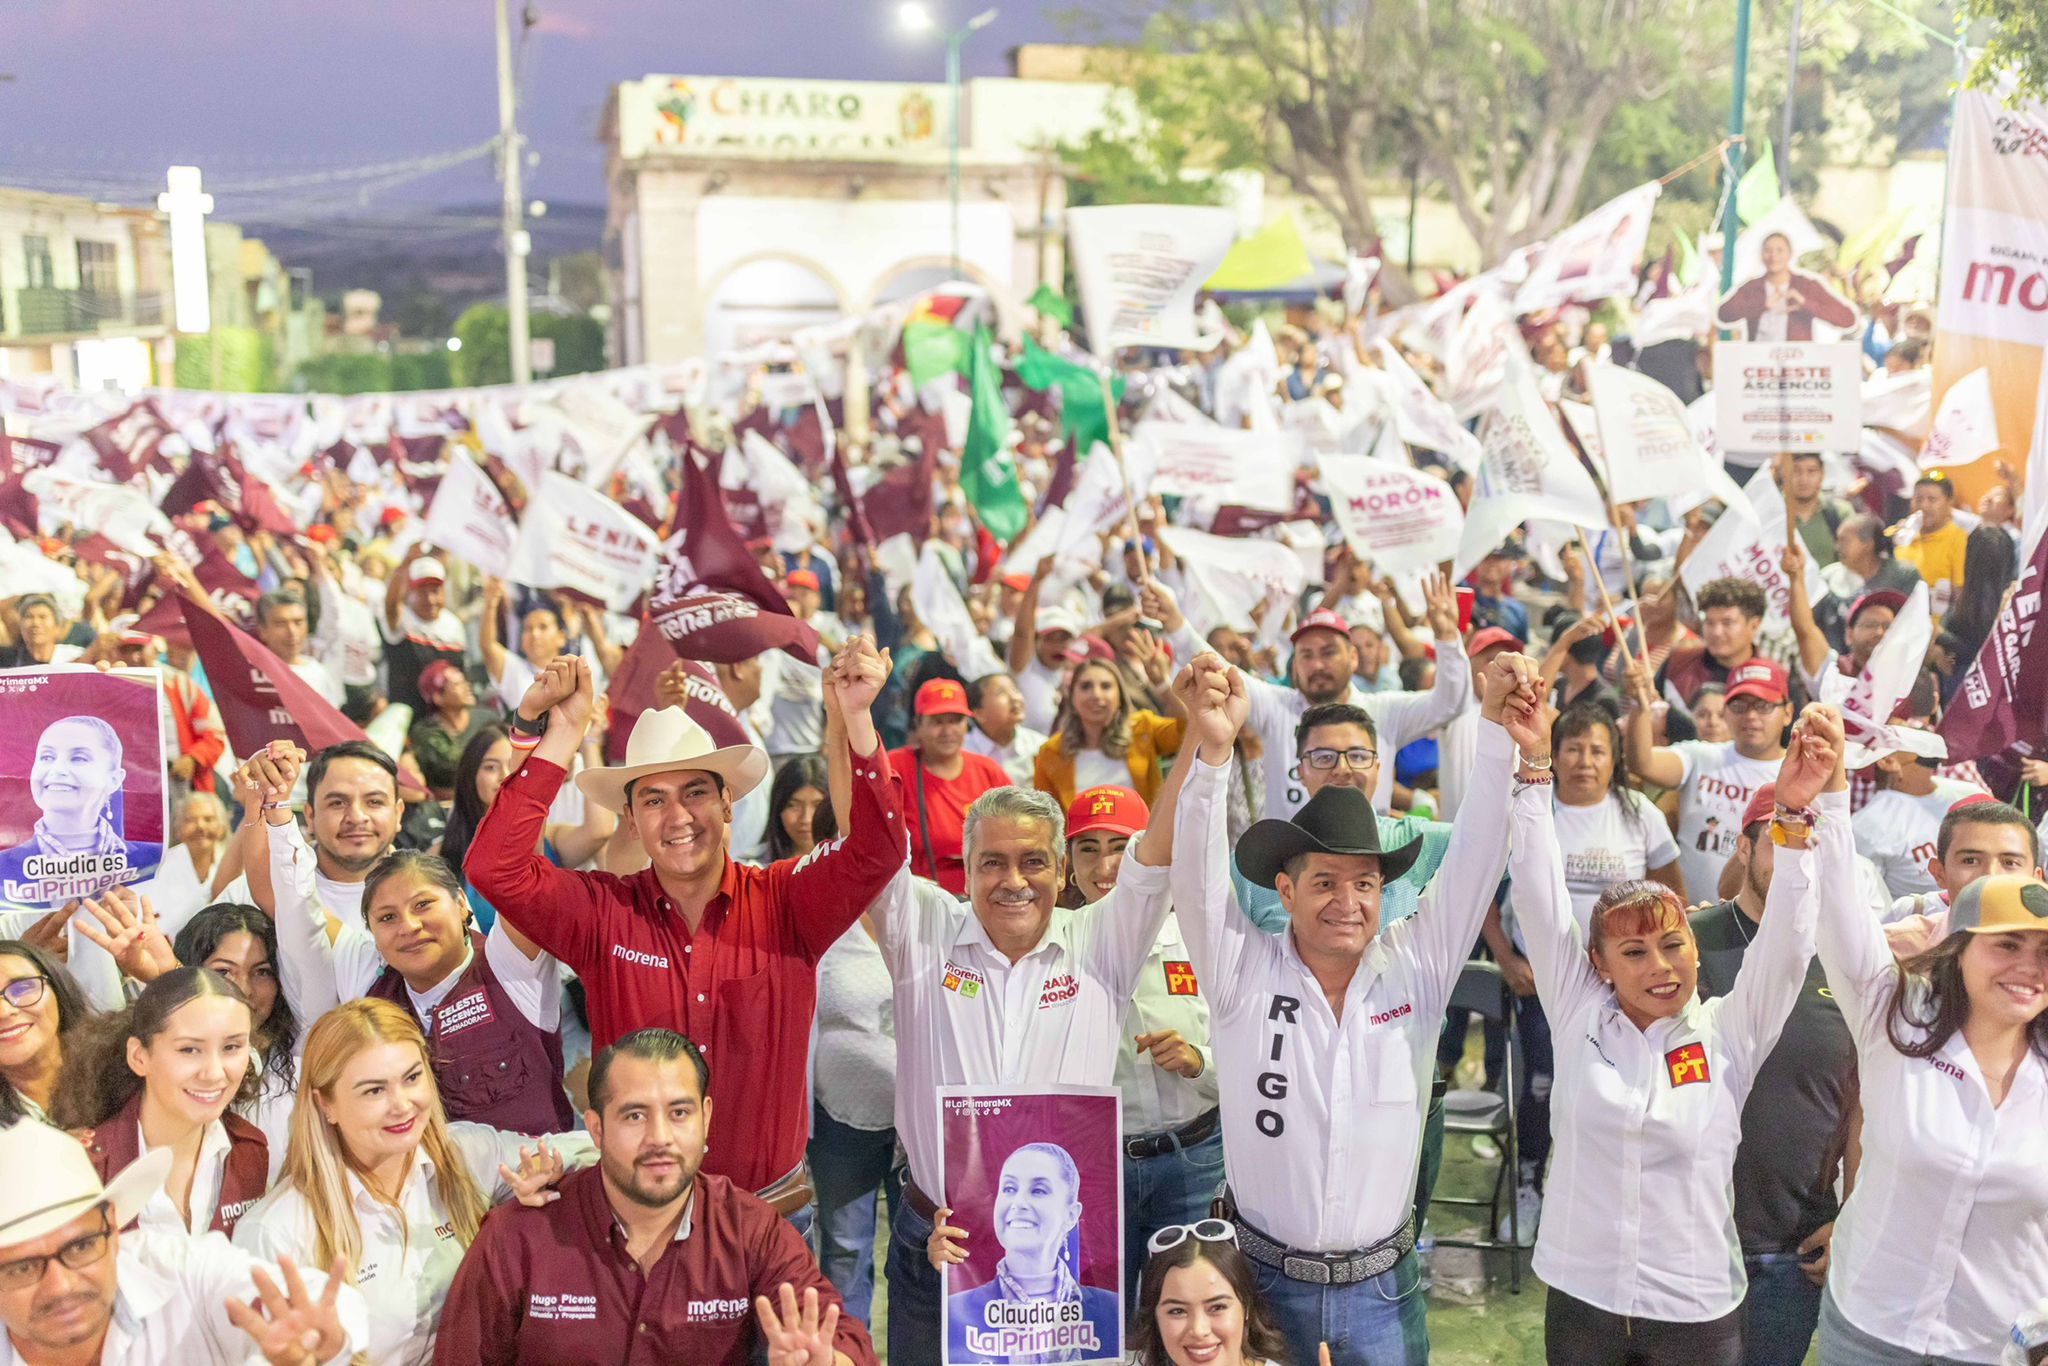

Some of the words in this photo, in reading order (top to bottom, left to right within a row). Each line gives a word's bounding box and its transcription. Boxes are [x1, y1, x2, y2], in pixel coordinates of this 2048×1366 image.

[1743, 367, 1832, 379] CELESTE
[1743, 380, 1832, 391] ASCENCIO
[1348, 484, 1441, 512] MORÓN
[565, 516, 648, 553] LENIN
[1092, 801, 1114, 815] PT
[27, 854, 97, 877] Claudia
[103, 856, 123, 872] es
[1566, 861, 1626, 873] ROMERO
[612, 944, 669, 969] morena
[944, 962, 985, 985] morena
[1043, 974, 1075, 991] RAÚL
[1169, 973, 1196, 994] PT
[438, 992, 485, 1020] CELESTE
[440, 1003, 488, 1030] ASCENCIO
[1370, 1002, 1412, 1026] morena
[449, 1014, 482, 1033] SENADORA
[1255, 994, 1301, 1138] RIGO
[1672, 1057, 1705, 1084] PT
[945, 1098, 1012, 1109] #LaPrimeraMX
[531, 1294, 557, 1306] Hugo
[561, 1294, 597, 1304] Piceno
[688, 1297, 749, 1315] morena
[988, 1302, 1055, 1325] Claudia
[1061, 1303, 1080, 1321] es
